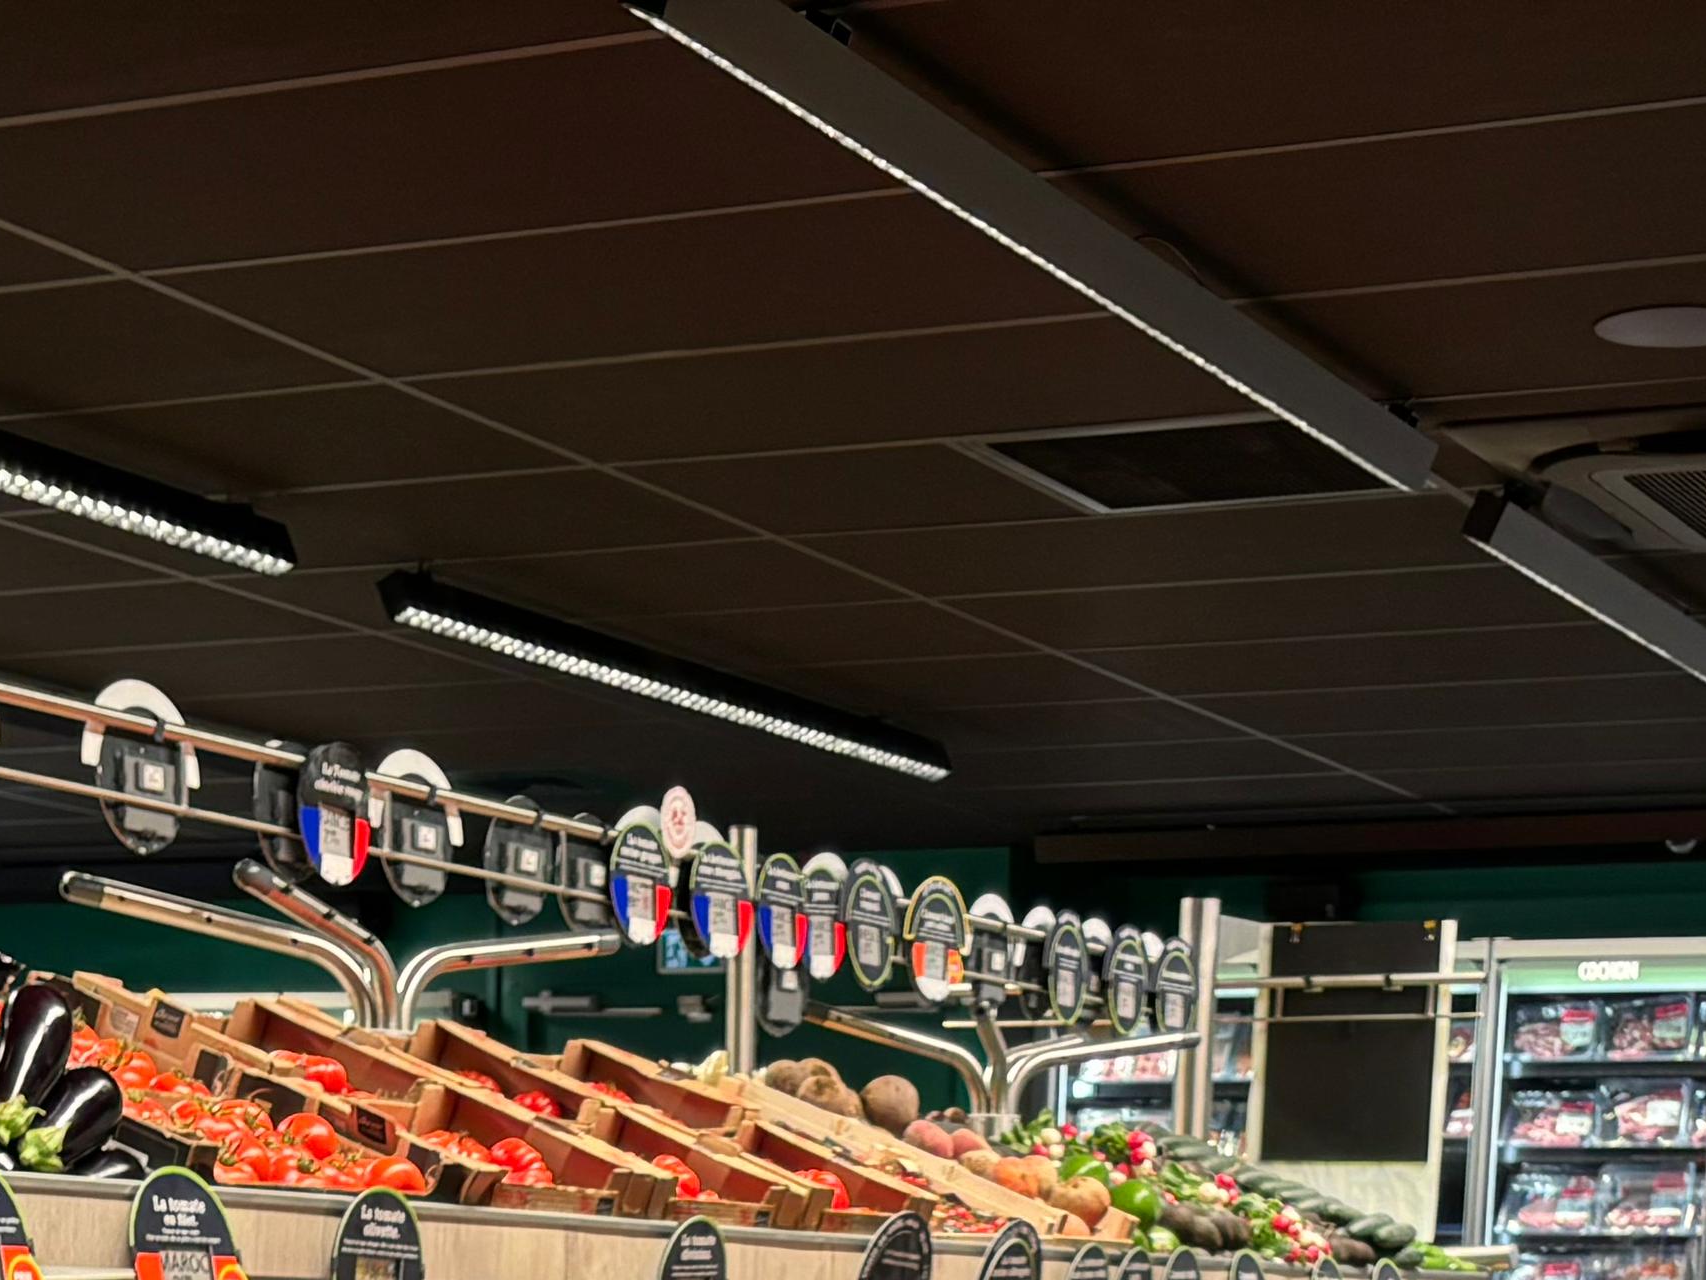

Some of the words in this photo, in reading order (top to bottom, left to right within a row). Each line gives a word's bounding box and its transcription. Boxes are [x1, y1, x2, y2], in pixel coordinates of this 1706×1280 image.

[152, 1193, 168, 1213] La
[168, 1195, 206, 1215] tomate
[360, 1203, 373, 1219] La
